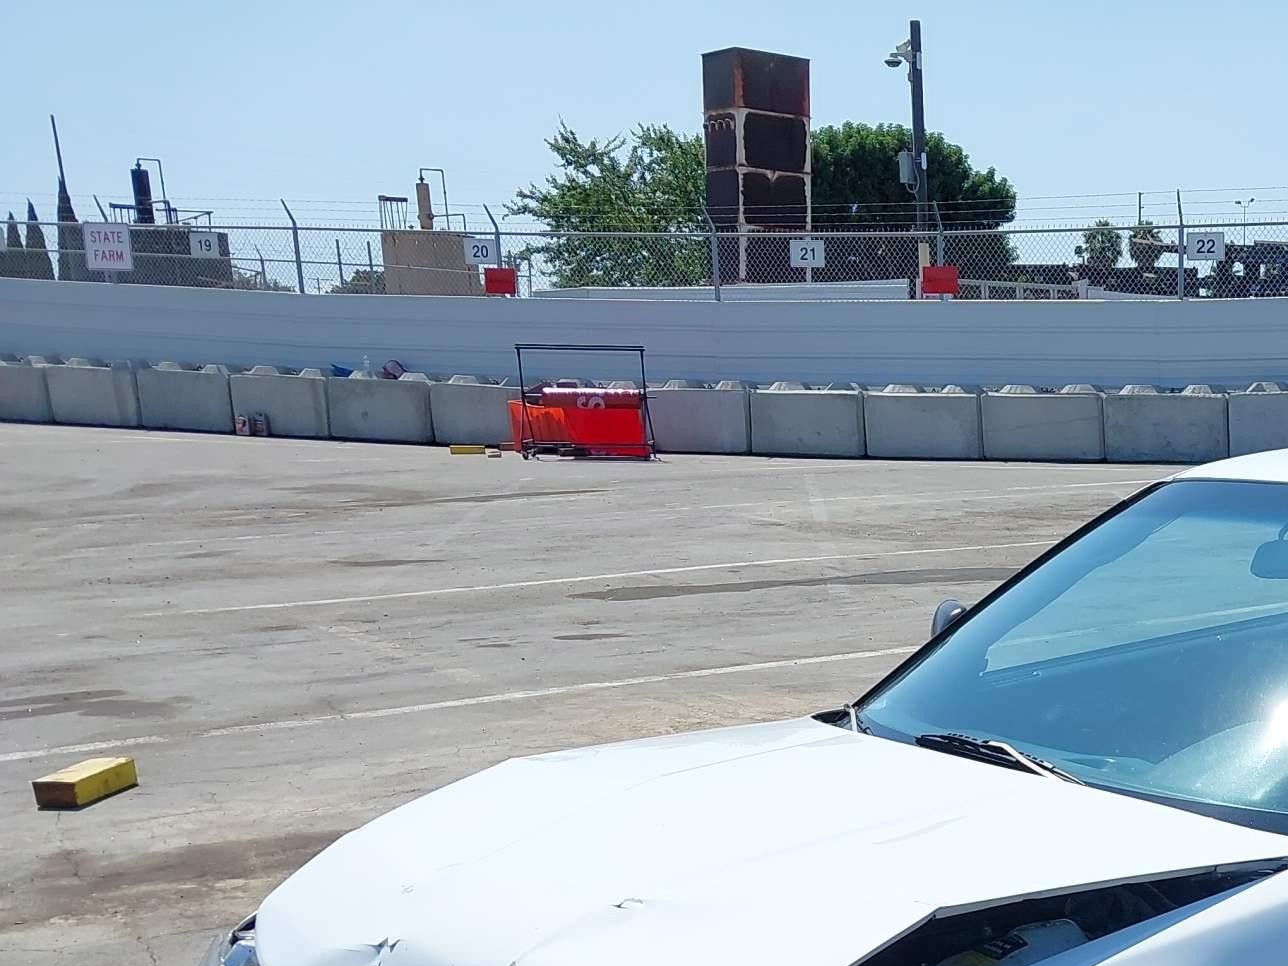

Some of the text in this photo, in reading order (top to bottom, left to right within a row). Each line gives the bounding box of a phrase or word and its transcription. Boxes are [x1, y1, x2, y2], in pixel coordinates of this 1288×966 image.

[90, 231, 123, 243] STATE
[197, 239, 212, 251] 19
[472, 245, 489, 258] 20
[1196, 239, 1216, 254] 22
[94, 250, 125, 263] FARM
[800, 247, 816, 261] 21
